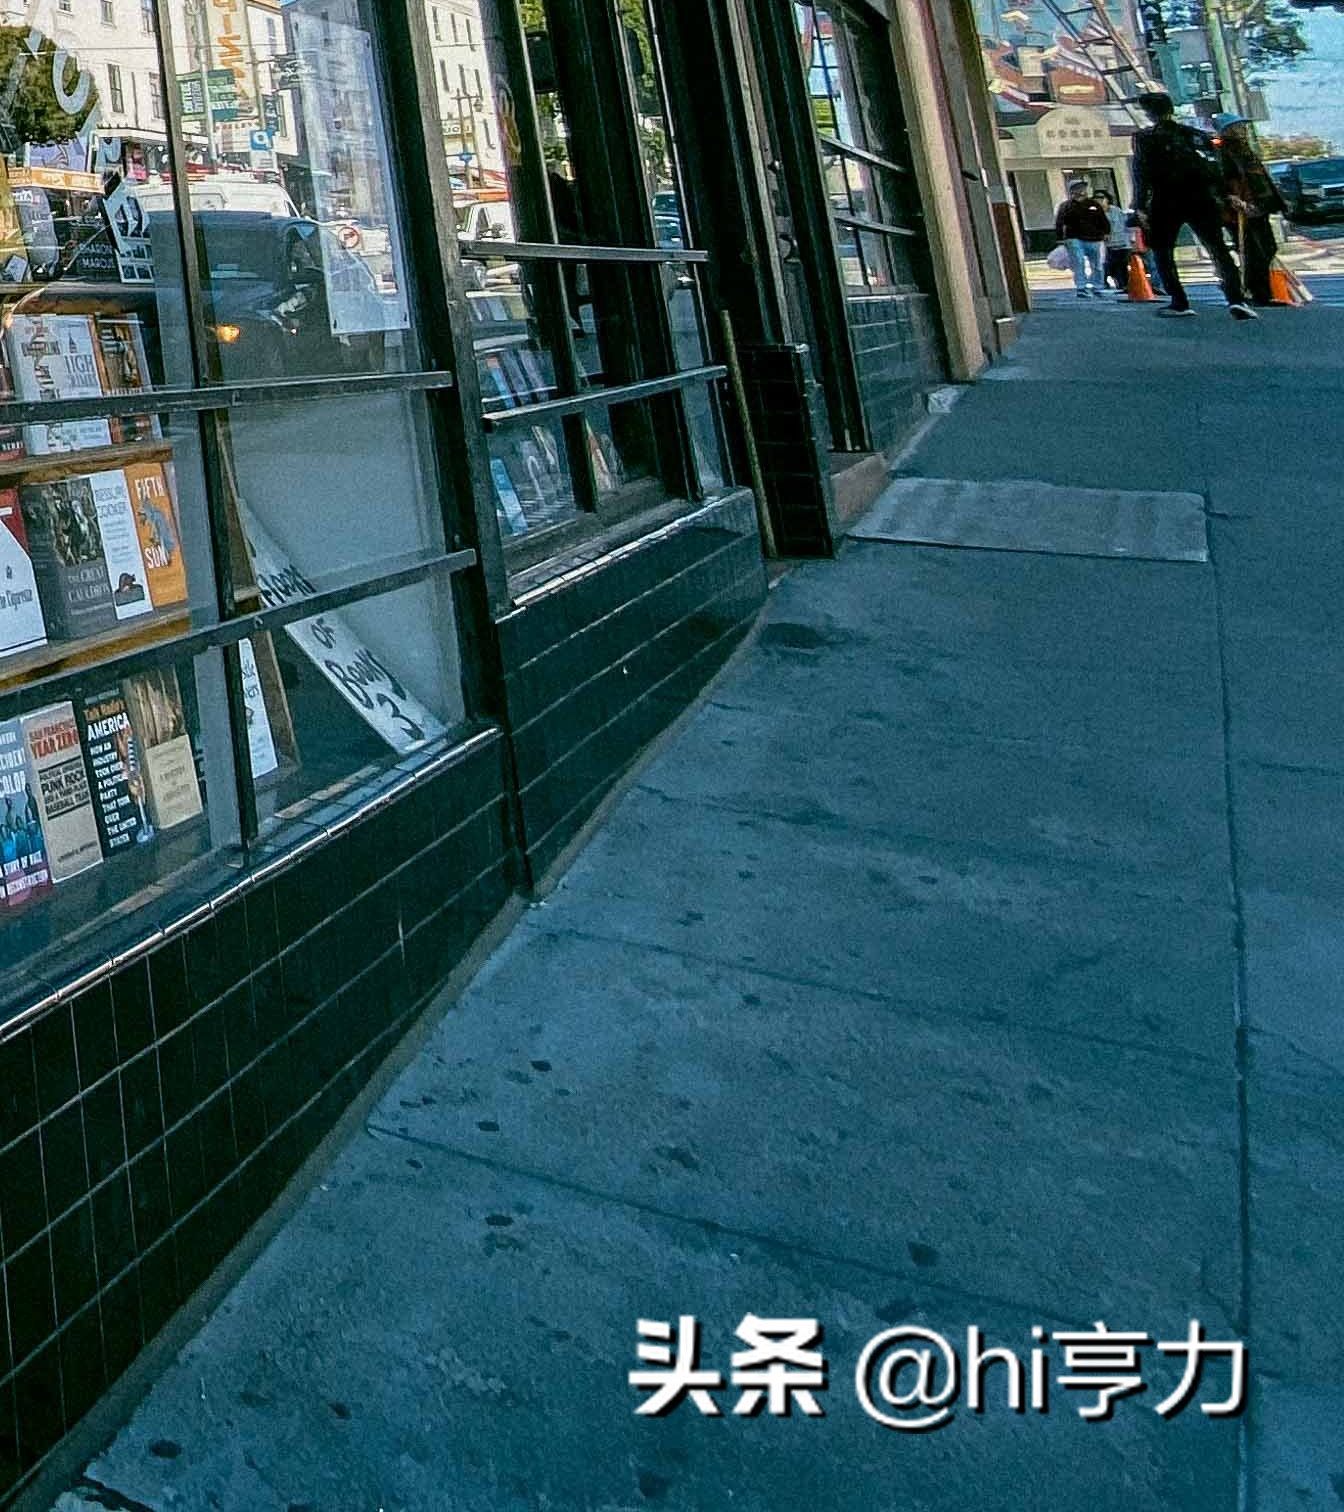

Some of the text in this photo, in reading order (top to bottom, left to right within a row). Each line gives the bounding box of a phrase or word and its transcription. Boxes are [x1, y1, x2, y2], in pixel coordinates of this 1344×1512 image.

[133, 475, 165, 501] FIFTH
[145, 545, 169, 569] SUN
[86, 711, 131, 741] AMERICA
